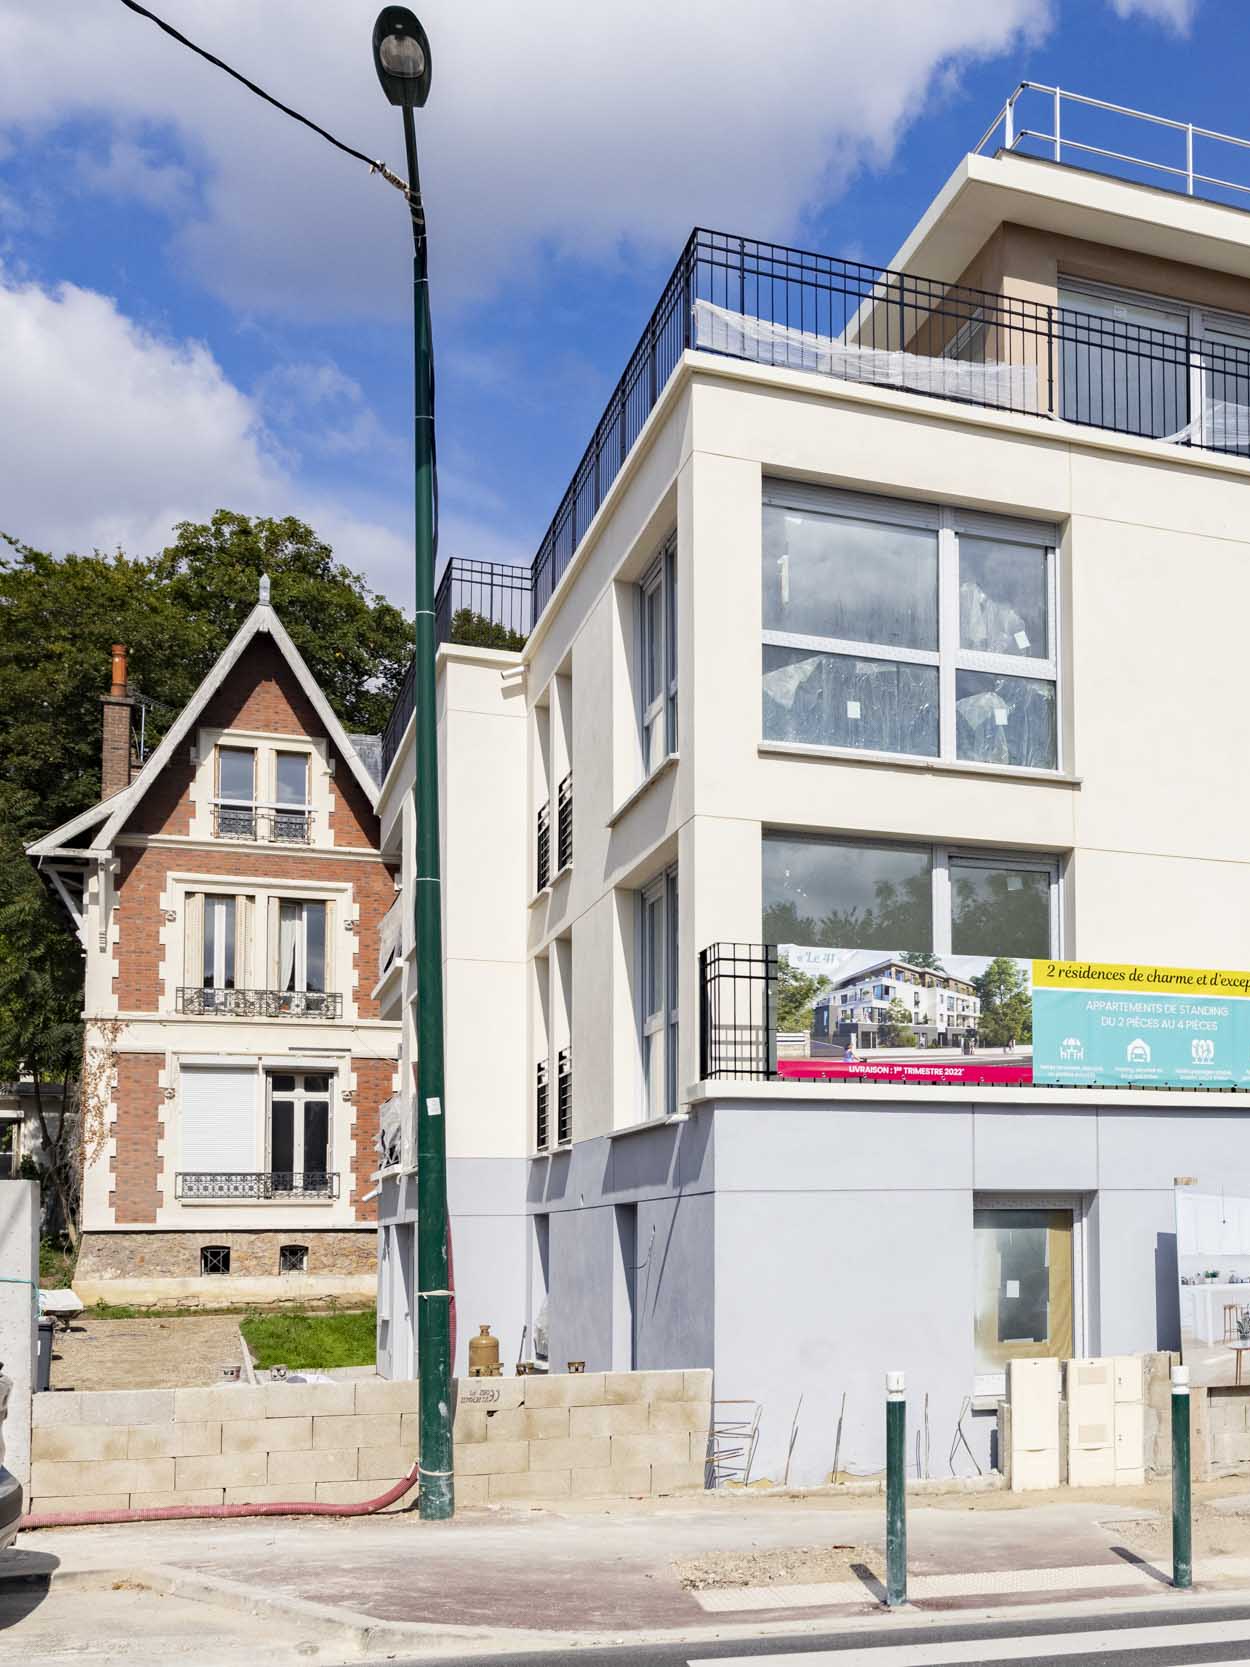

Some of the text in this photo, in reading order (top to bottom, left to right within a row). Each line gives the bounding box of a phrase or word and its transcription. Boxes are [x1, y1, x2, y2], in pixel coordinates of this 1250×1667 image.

[1046, 964, 1056, 978] 2
[1058, 965, 1126, 981] résidences
[1128, 967, 1144, 982] de
[1146, 968, 1194, 985] charme
[1196, 972, 1208, 986] et
[1086, 1000, 1229, 1017] APPARTEMENTS DE STANDING
[1101, 1015, 1218, 1031] DU 2 PIÈCES AU 4 PIÈCES
[848, 1065, 889, 1074] LIVRAISON
[904, 1067, 943, 1075] TRIMESTRE
